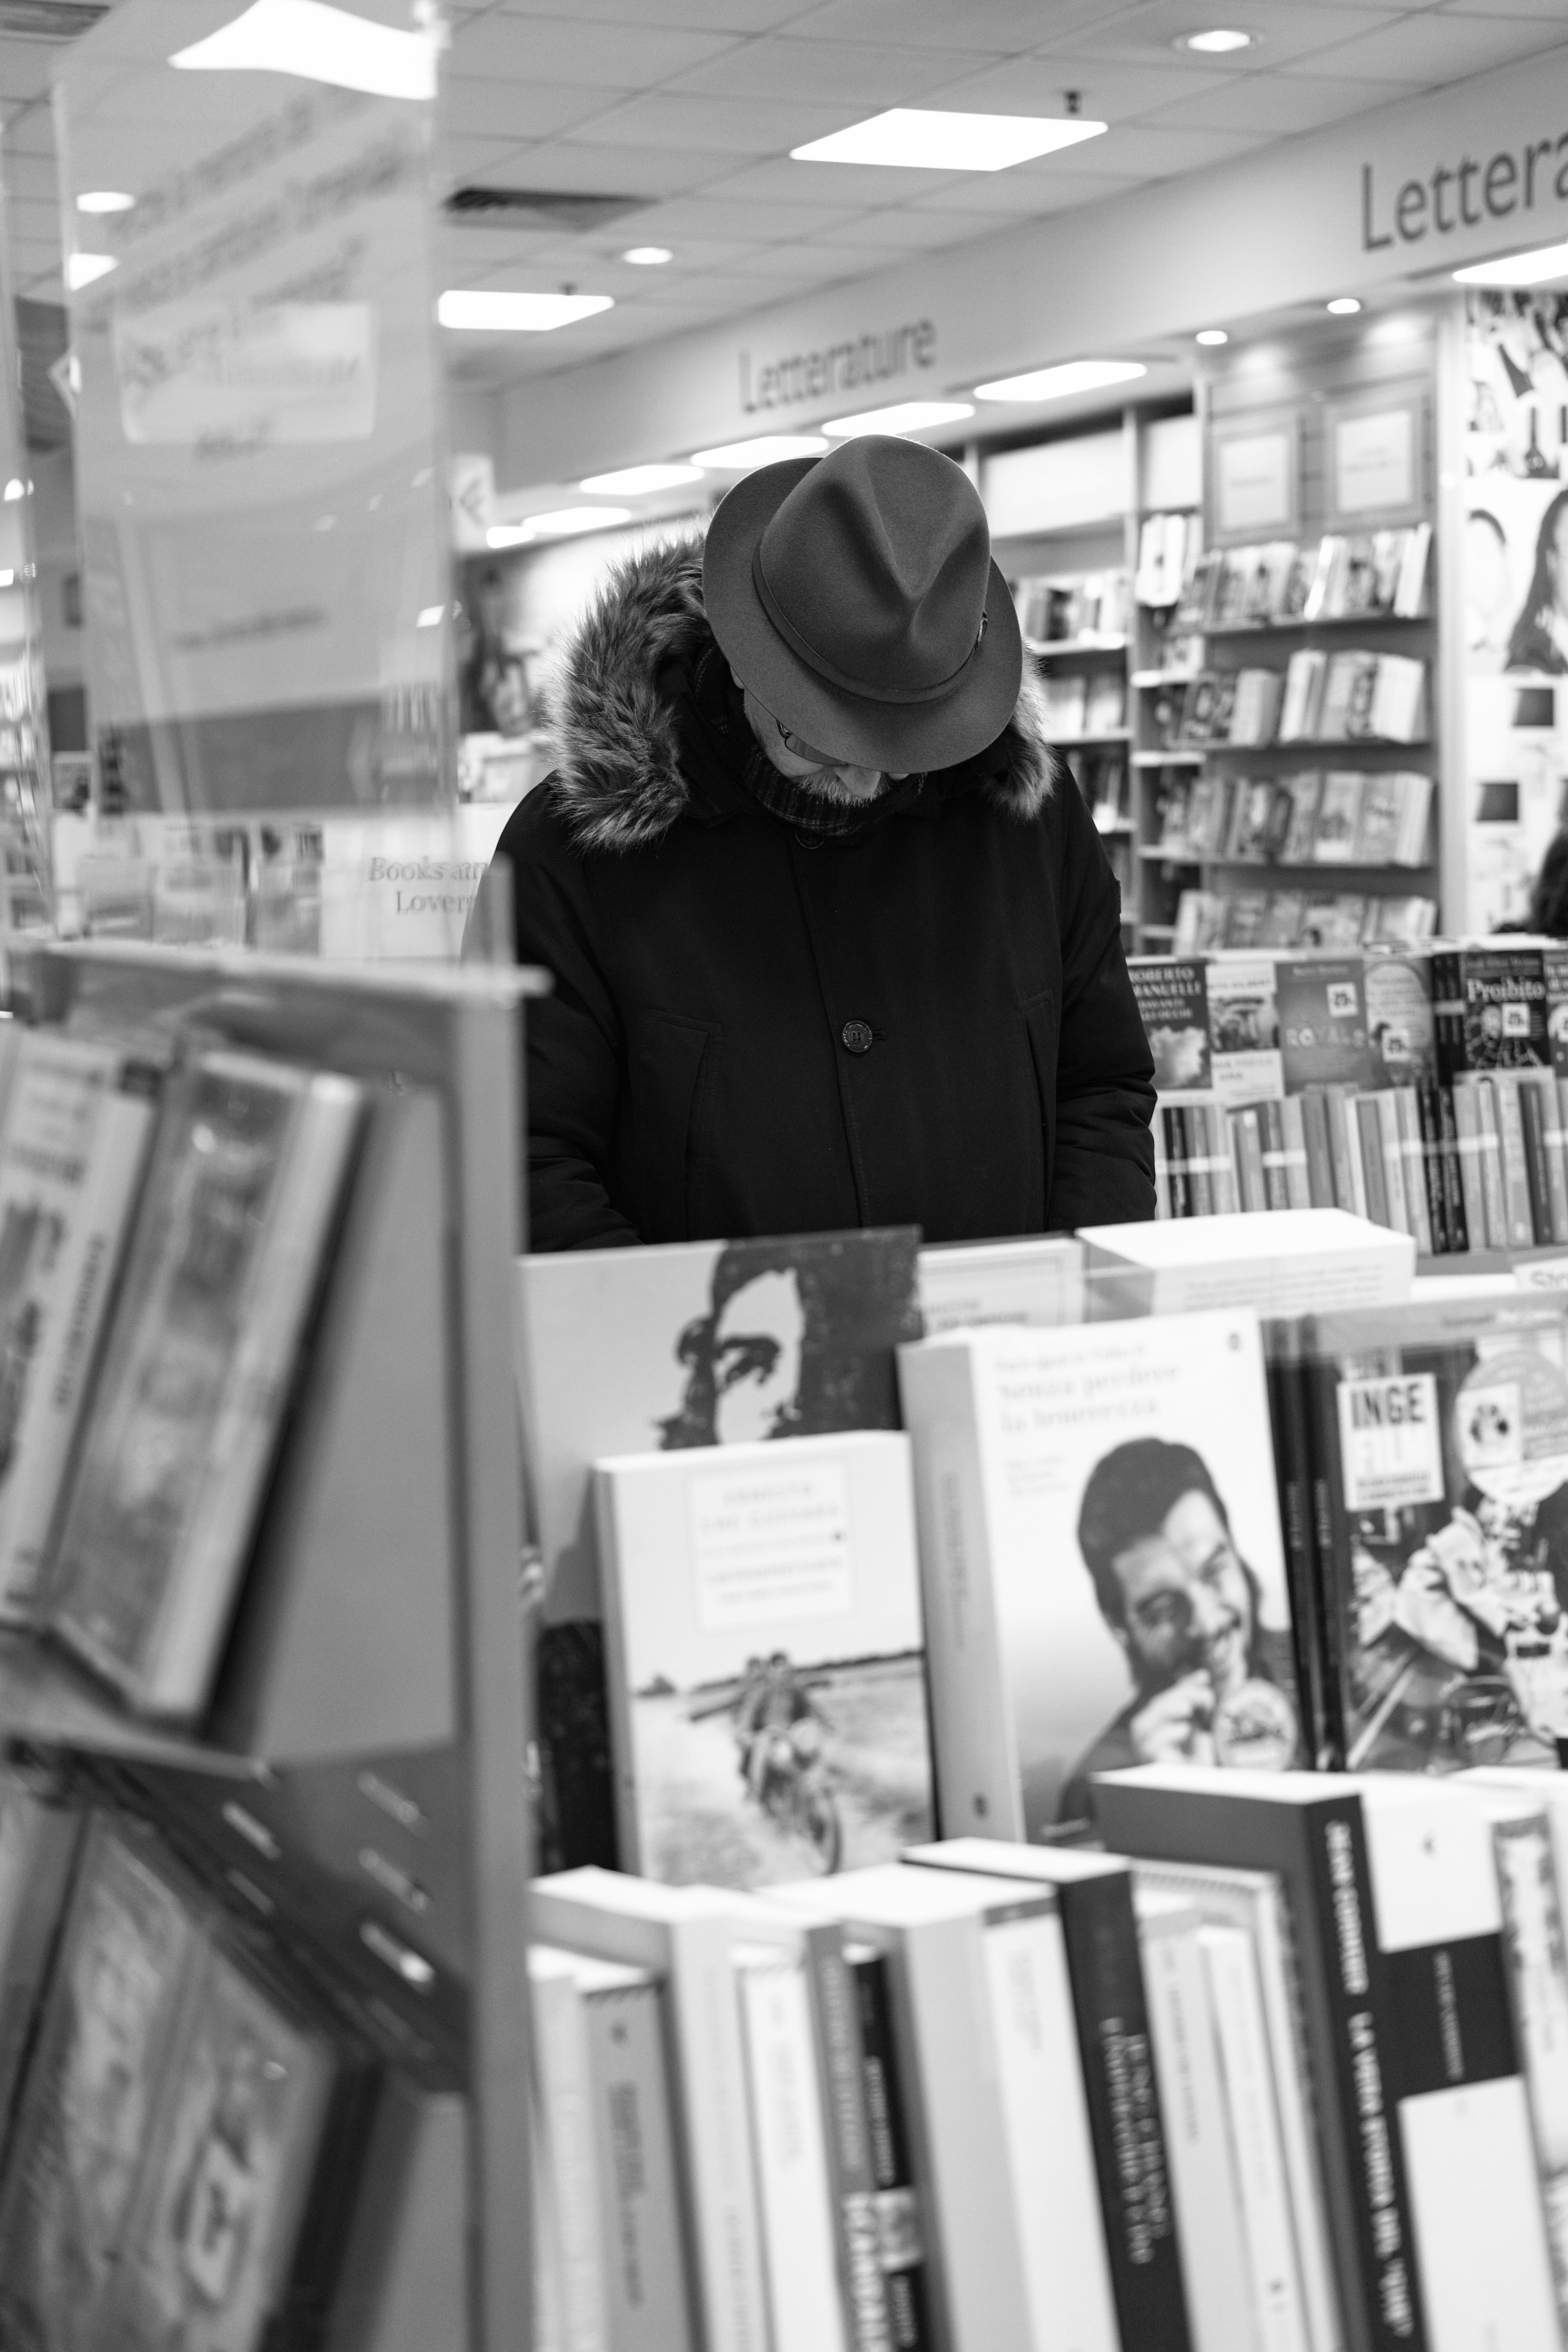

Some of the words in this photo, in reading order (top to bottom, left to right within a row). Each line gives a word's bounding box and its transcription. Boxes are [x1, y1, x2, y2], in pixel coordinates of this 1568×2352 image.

[369, 857, 446, 881] Books
[450, 862, 488, 880] an
[396, 890, 473, 915] Lover
[1467, 976, 1546, 1003] Proibito
[1351, 1383, 1425, 1429] INGE
